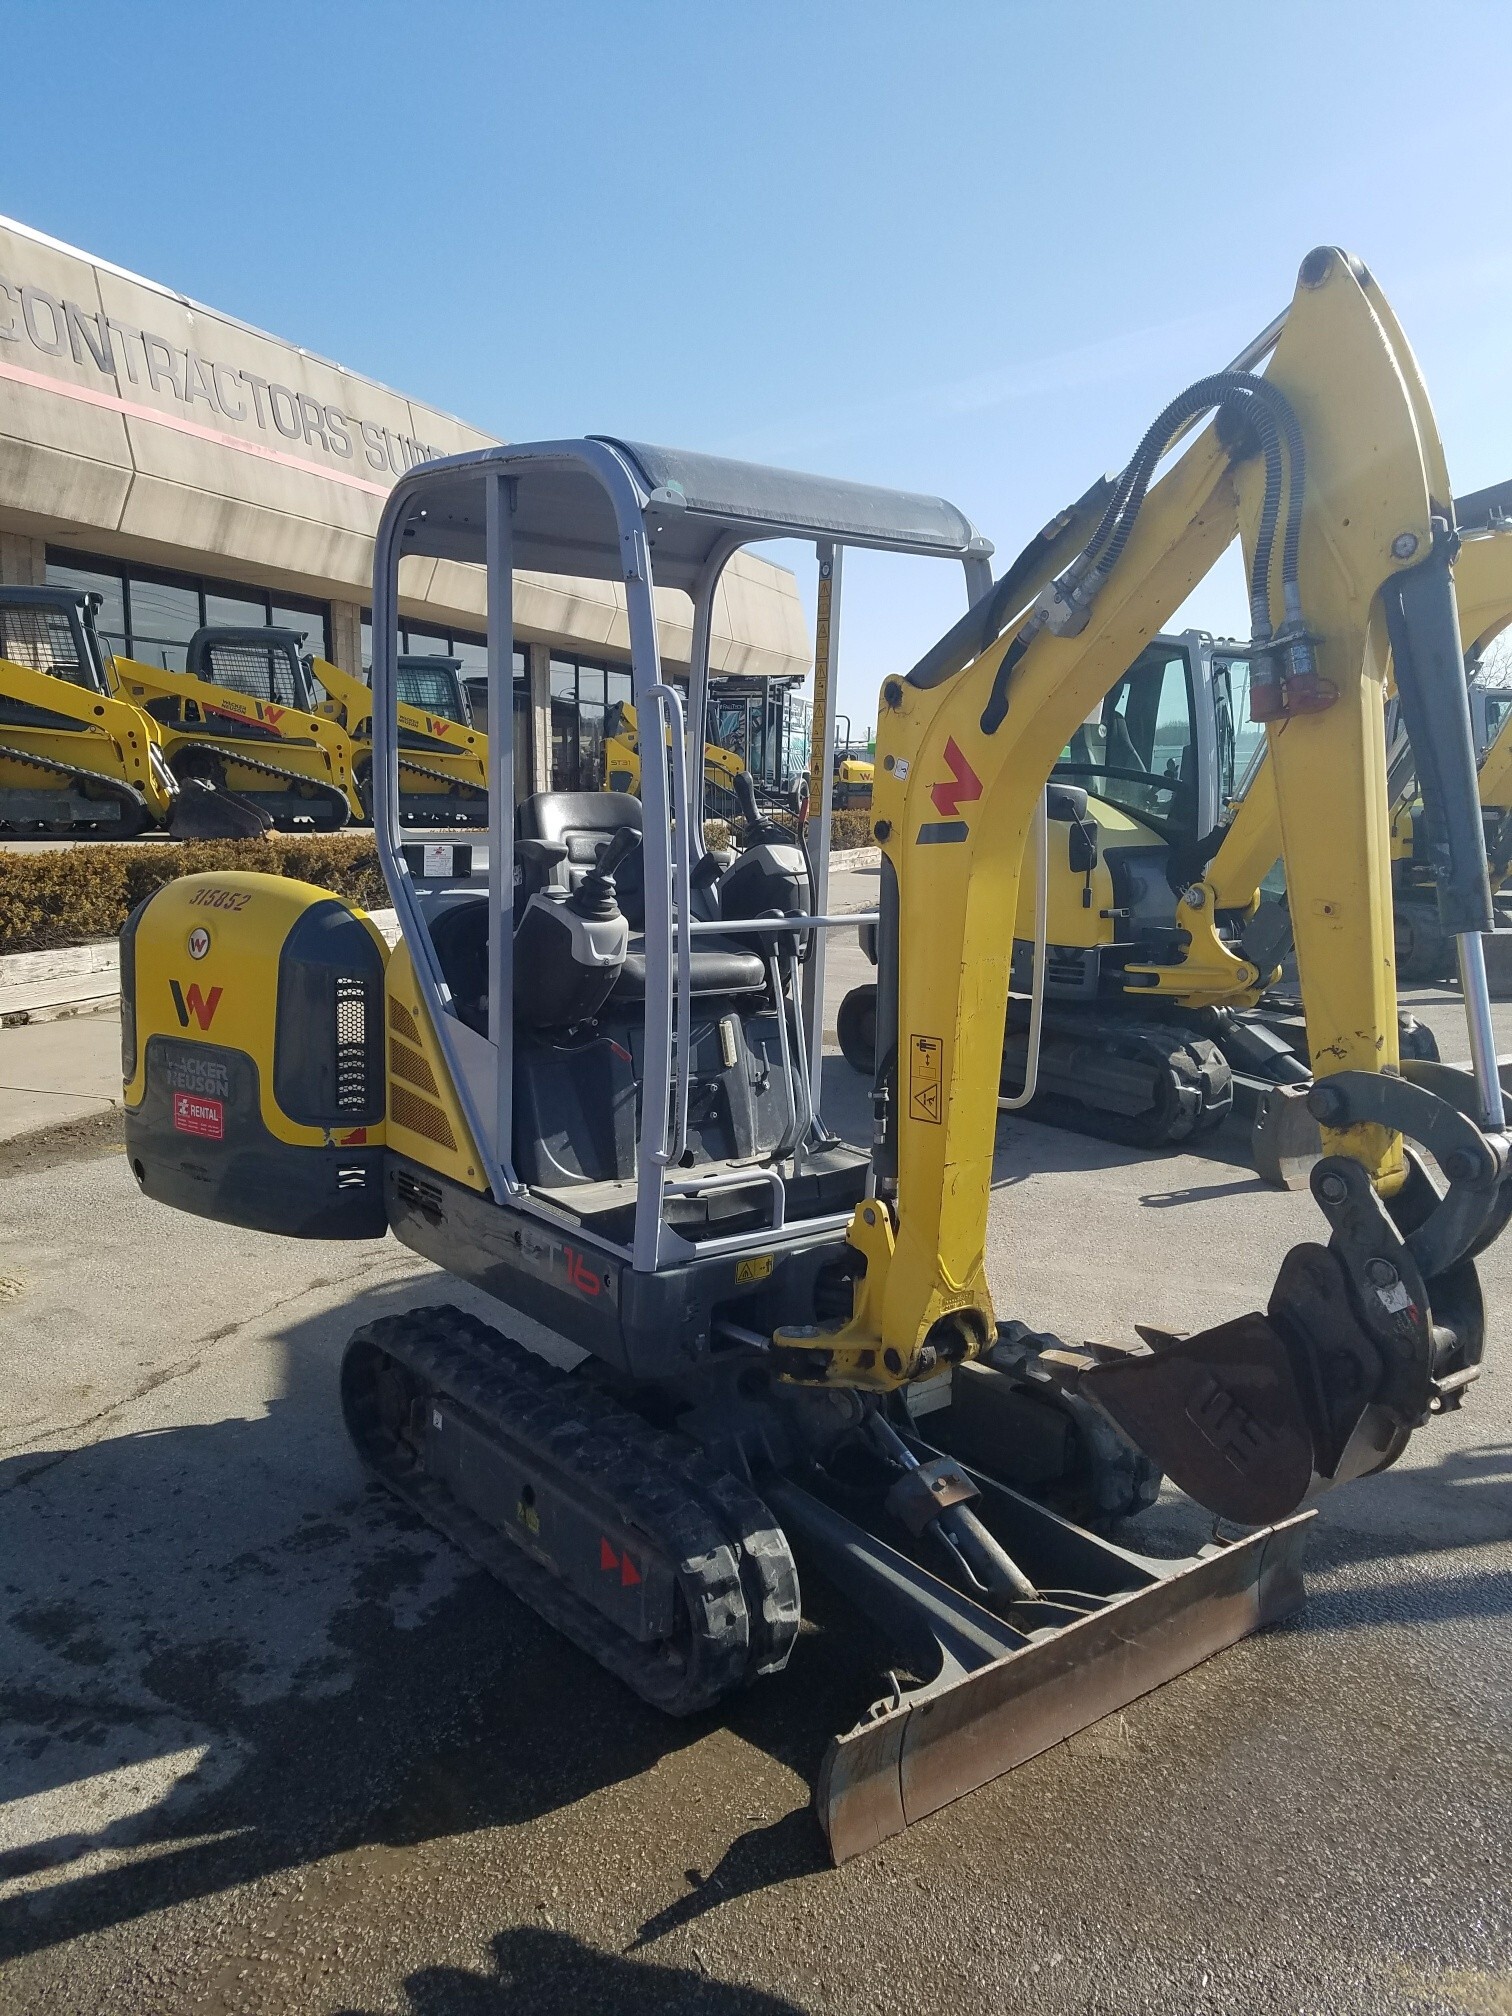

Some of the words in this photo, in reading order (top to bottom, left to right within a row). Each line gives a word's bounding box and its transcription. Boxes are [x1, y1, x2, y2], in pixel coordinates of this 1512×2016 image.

[360, 420, 451, 478] SUP
[188, 888, 252, 911] 315852
[190, 1104, 219, 1121] RENTAL
